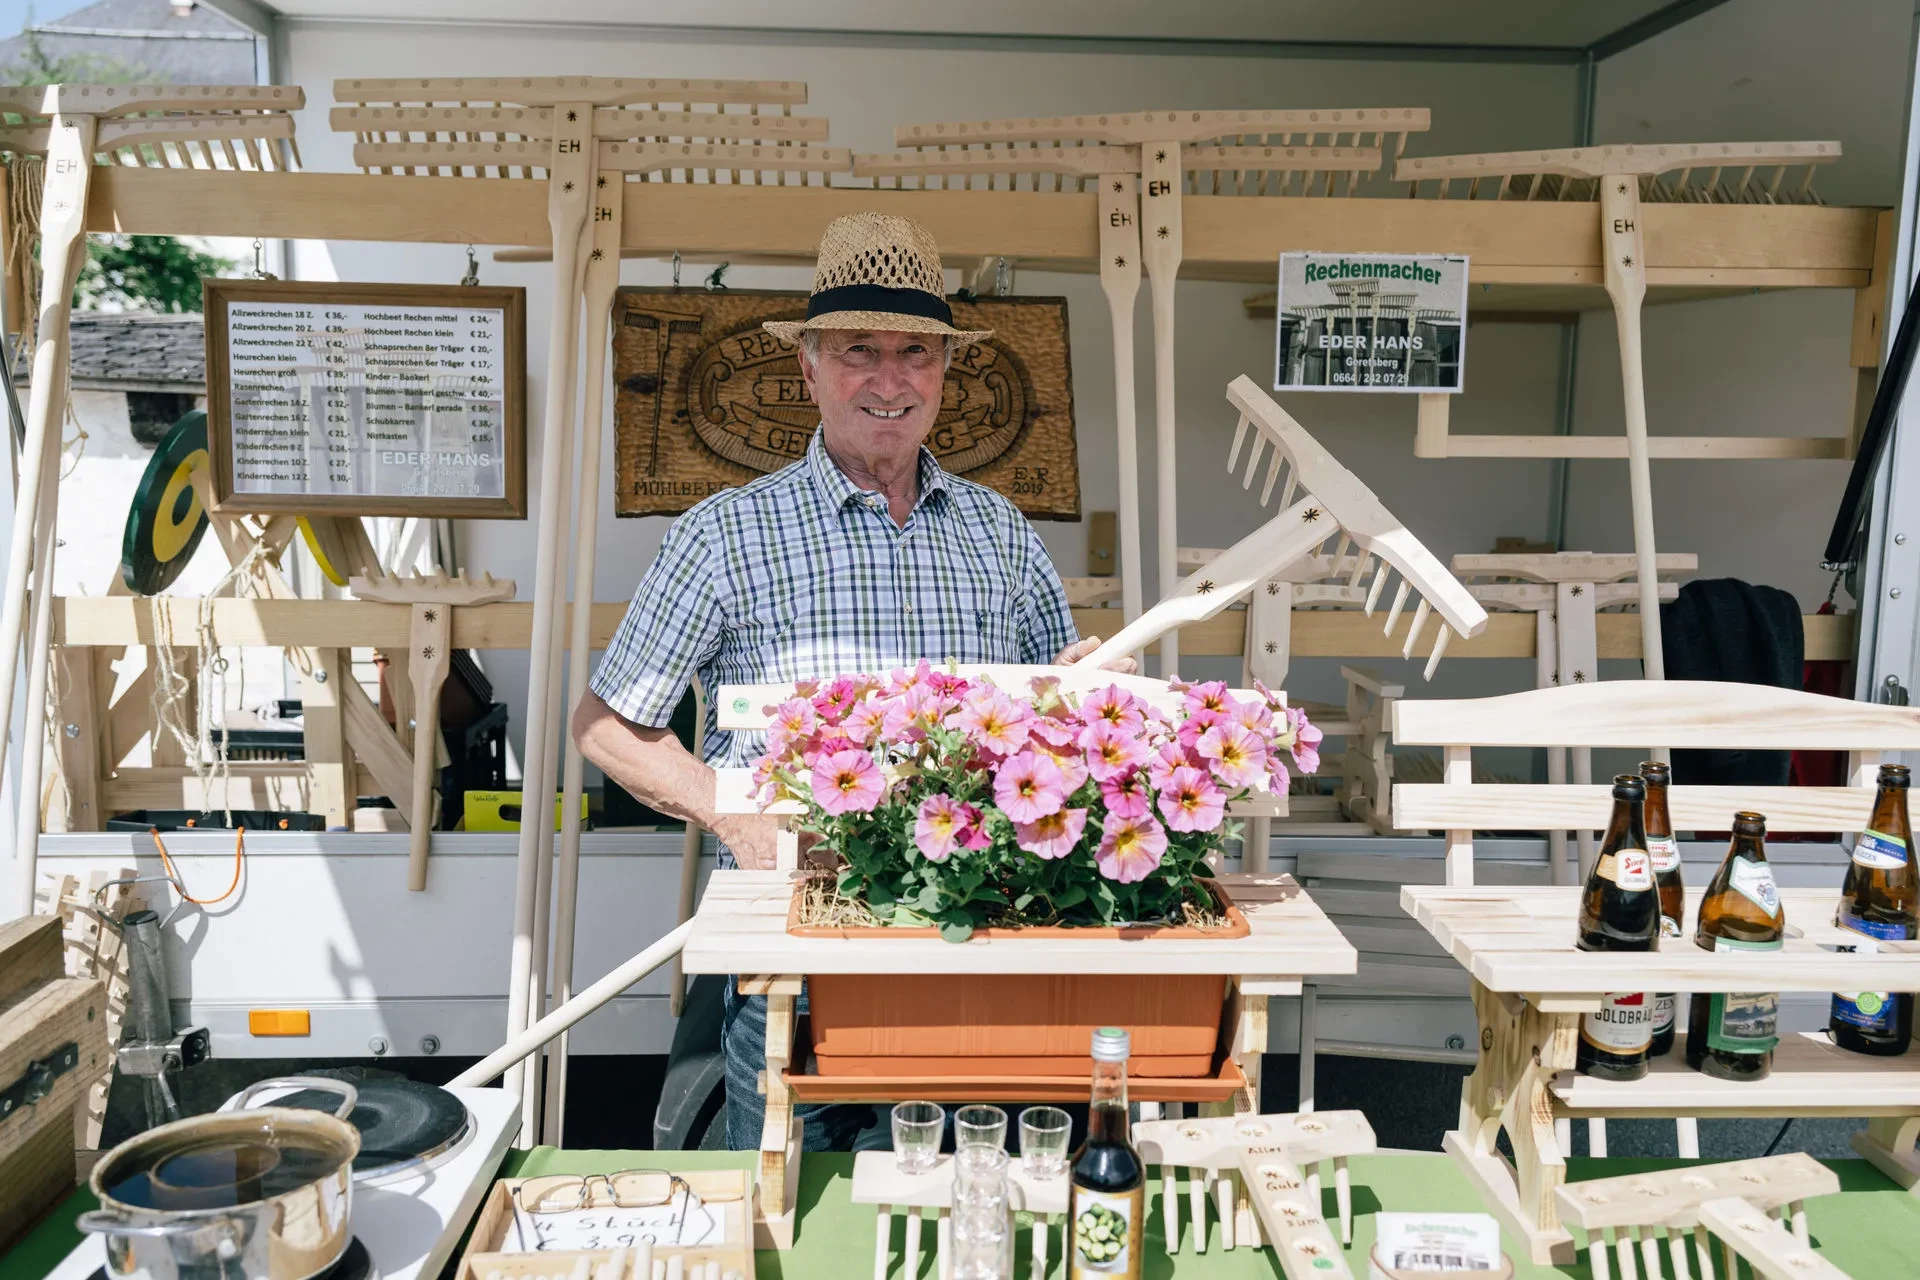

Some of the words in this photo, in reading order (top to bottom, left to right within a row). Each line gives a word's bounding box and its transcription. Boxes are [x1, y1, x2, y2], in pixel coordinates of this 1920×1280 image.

[559, 140, 580, 153] EH
[56, 160, 77, 174] EH
[1149, 181, 1170, 197] EH
[1110, 212, 1131, 227] EH
[1614, 219, 1635, 233] EH
[1305, 259, 1441, 285] Rechenmacher
[231, 309, 292, 318] Allzweckrechen
[470, 315, 475, 323] €
[364, 328, 402, 336] Hochbeet
[470, 330, 476, 338] €
[1319, 335, 1366, 349] EDER
[1373, 335, 1423, 350] HANS
[233, 353, 275, 361] Heurechen
[278, 354, 297, 362] klein
[1346, 357, 1398, 369] Geretsberg
[366, 417, 415, 425] Schubkarren
[366, 432, 408, 440] Nistkasten
[383, 452, 431, 465] EDER
[439, 453, 490, 467] HANS
[1012, 482, 1044, 496] 2019
